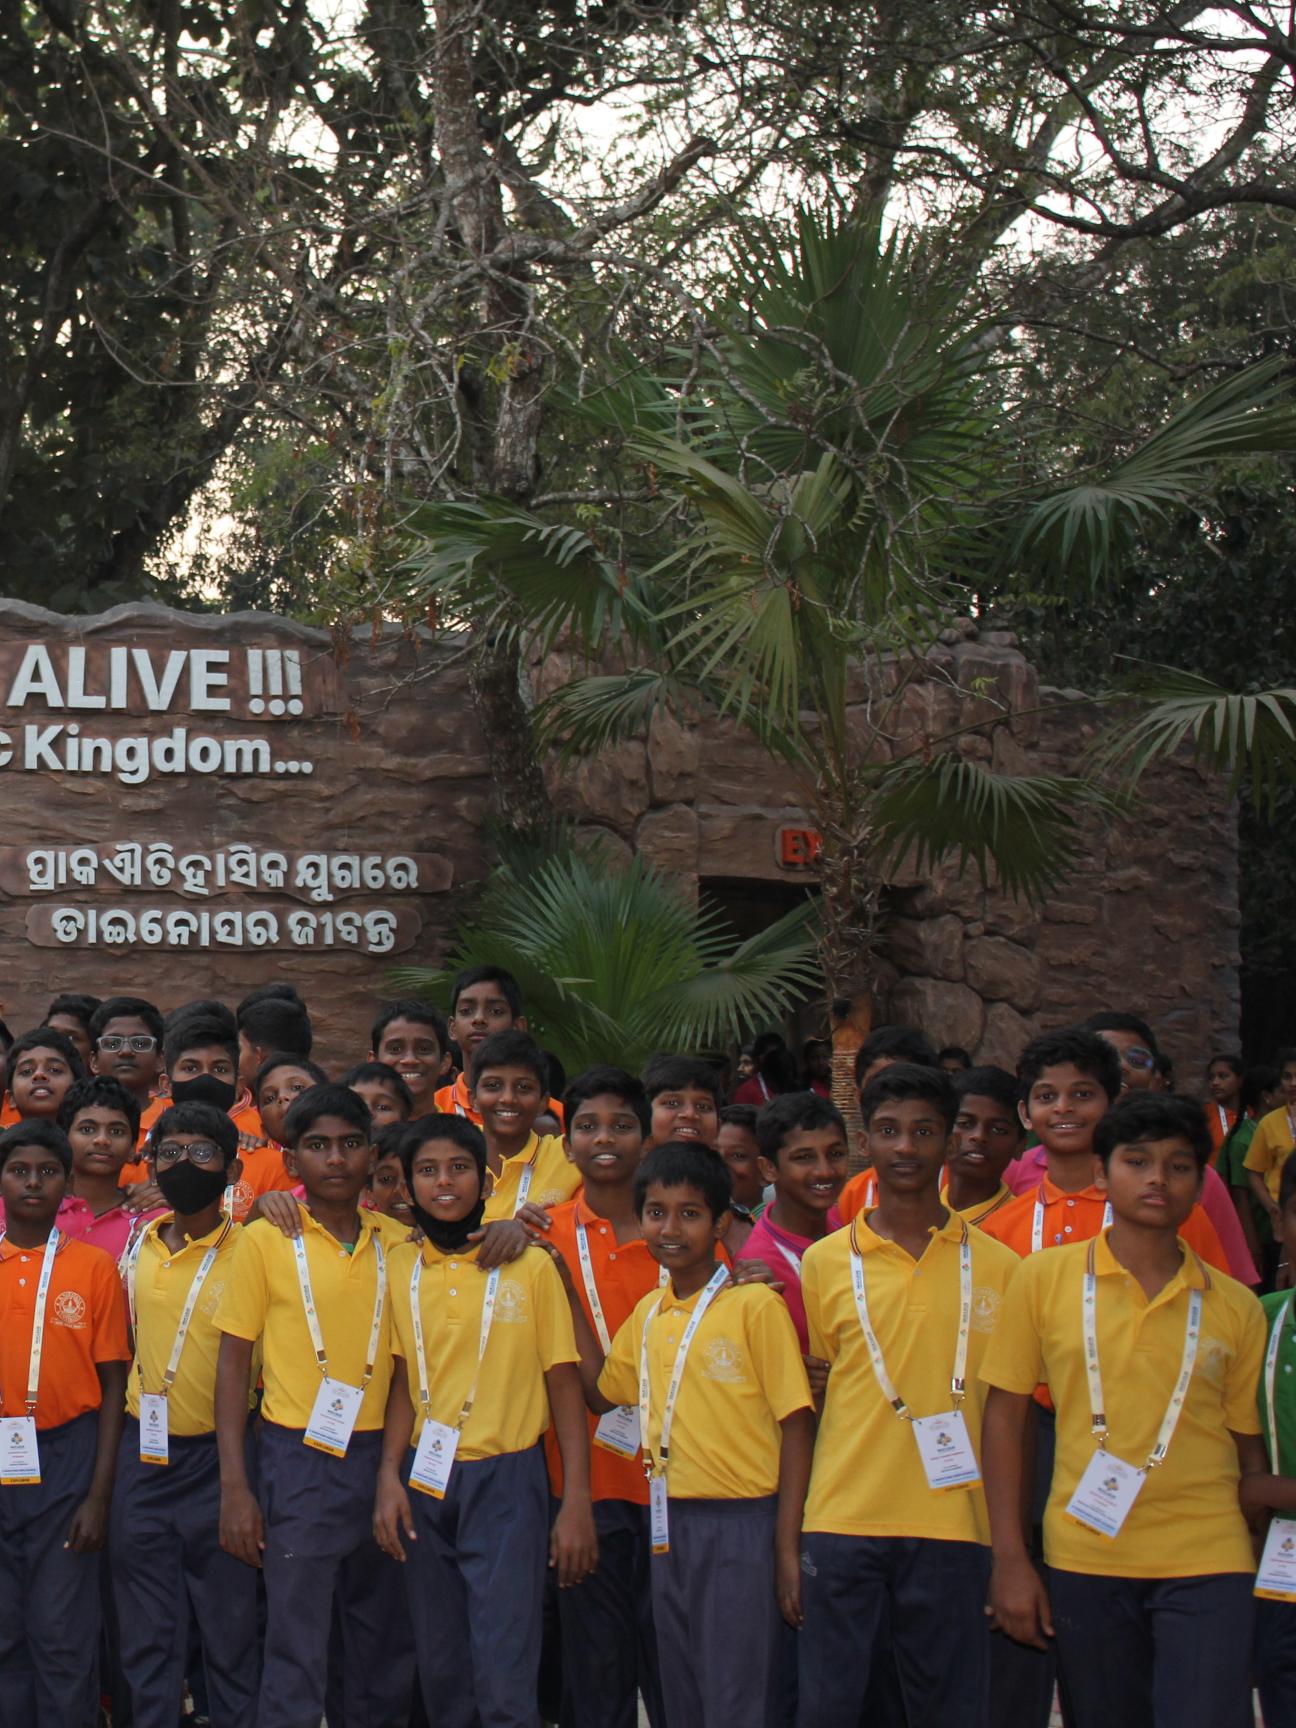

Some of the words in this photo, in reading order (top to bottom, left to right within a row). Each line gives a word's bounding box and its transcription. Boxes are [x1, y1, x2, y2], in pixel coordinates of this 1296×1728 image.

[7, 644, 231, 711] ALIVE
[24, 722, 314, 785] Kingdom...
[51, 907, 281, 947] ଡାଇନୋସର
[287, 909, 398, 953] ଜୀବନ୍ତ
